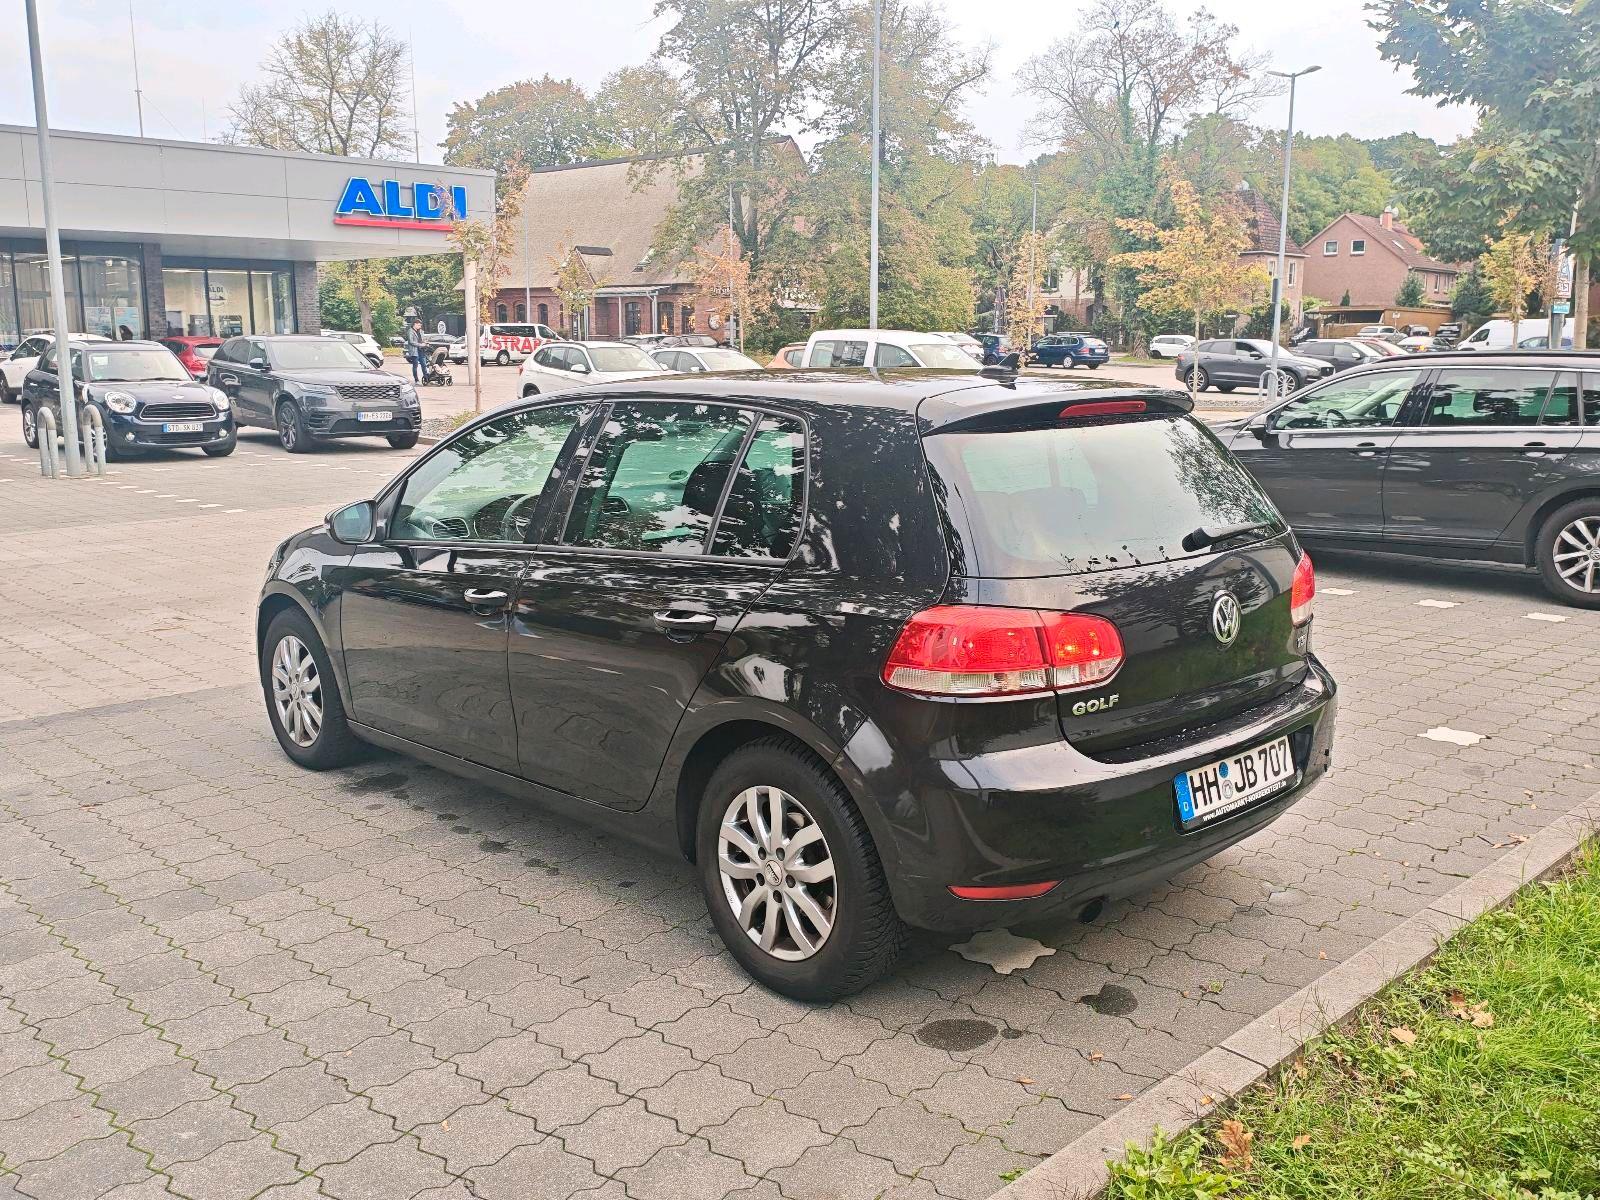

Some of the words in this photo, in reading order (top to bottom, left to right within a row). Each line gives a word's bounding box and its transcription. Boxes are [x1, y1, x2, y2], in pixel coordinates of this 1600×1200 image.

[336, 176, 468, 221] ALDI
[1072, 693, 1120, 716] GOLF
[1190, 767, 1222, 810] HH
[1234, 754, 1258, 794] JB
[1258, 738, 1288, 782] 707
